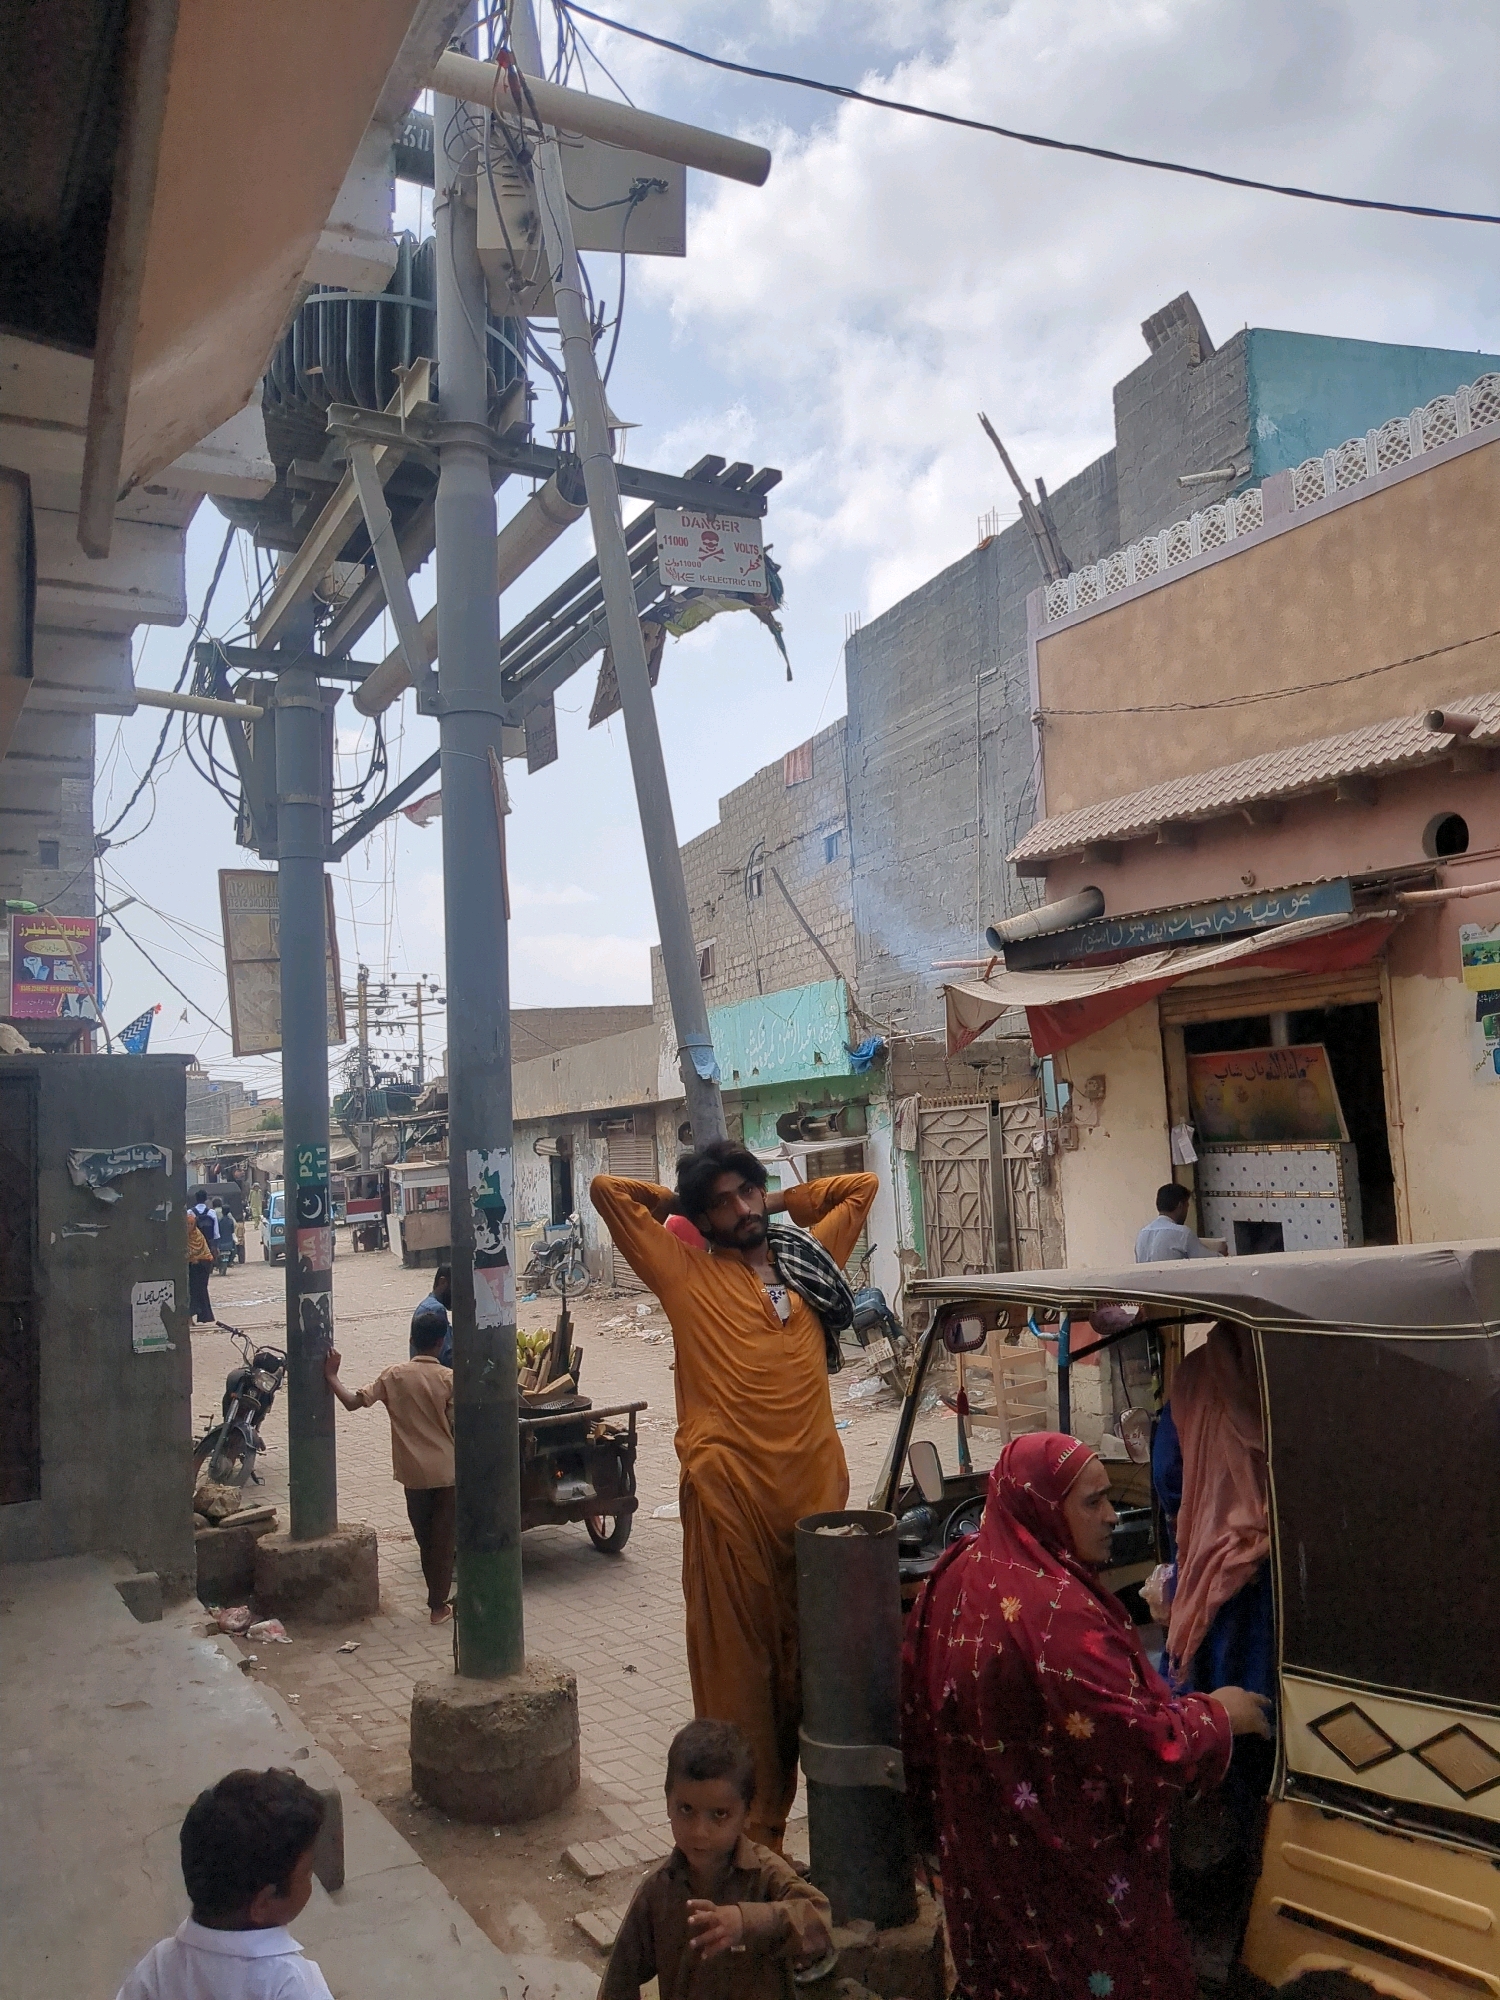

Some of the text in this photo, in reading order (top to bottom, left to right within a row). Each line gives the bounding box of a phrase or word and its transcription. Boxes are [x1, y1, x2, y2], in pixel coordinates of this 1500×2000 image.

[681, 516, 740, 533] DANGER
[663, 535, 759, 555] 11000 VOLTS
[699, 575, 746, 586] K-ELECTRIC
[747, 578, 762, 589] LTD
[106, 1147, 162, 1164] یونانی
[298, 1151, 313, 1178] PS
[315, 1146, 327, 1181] 111
